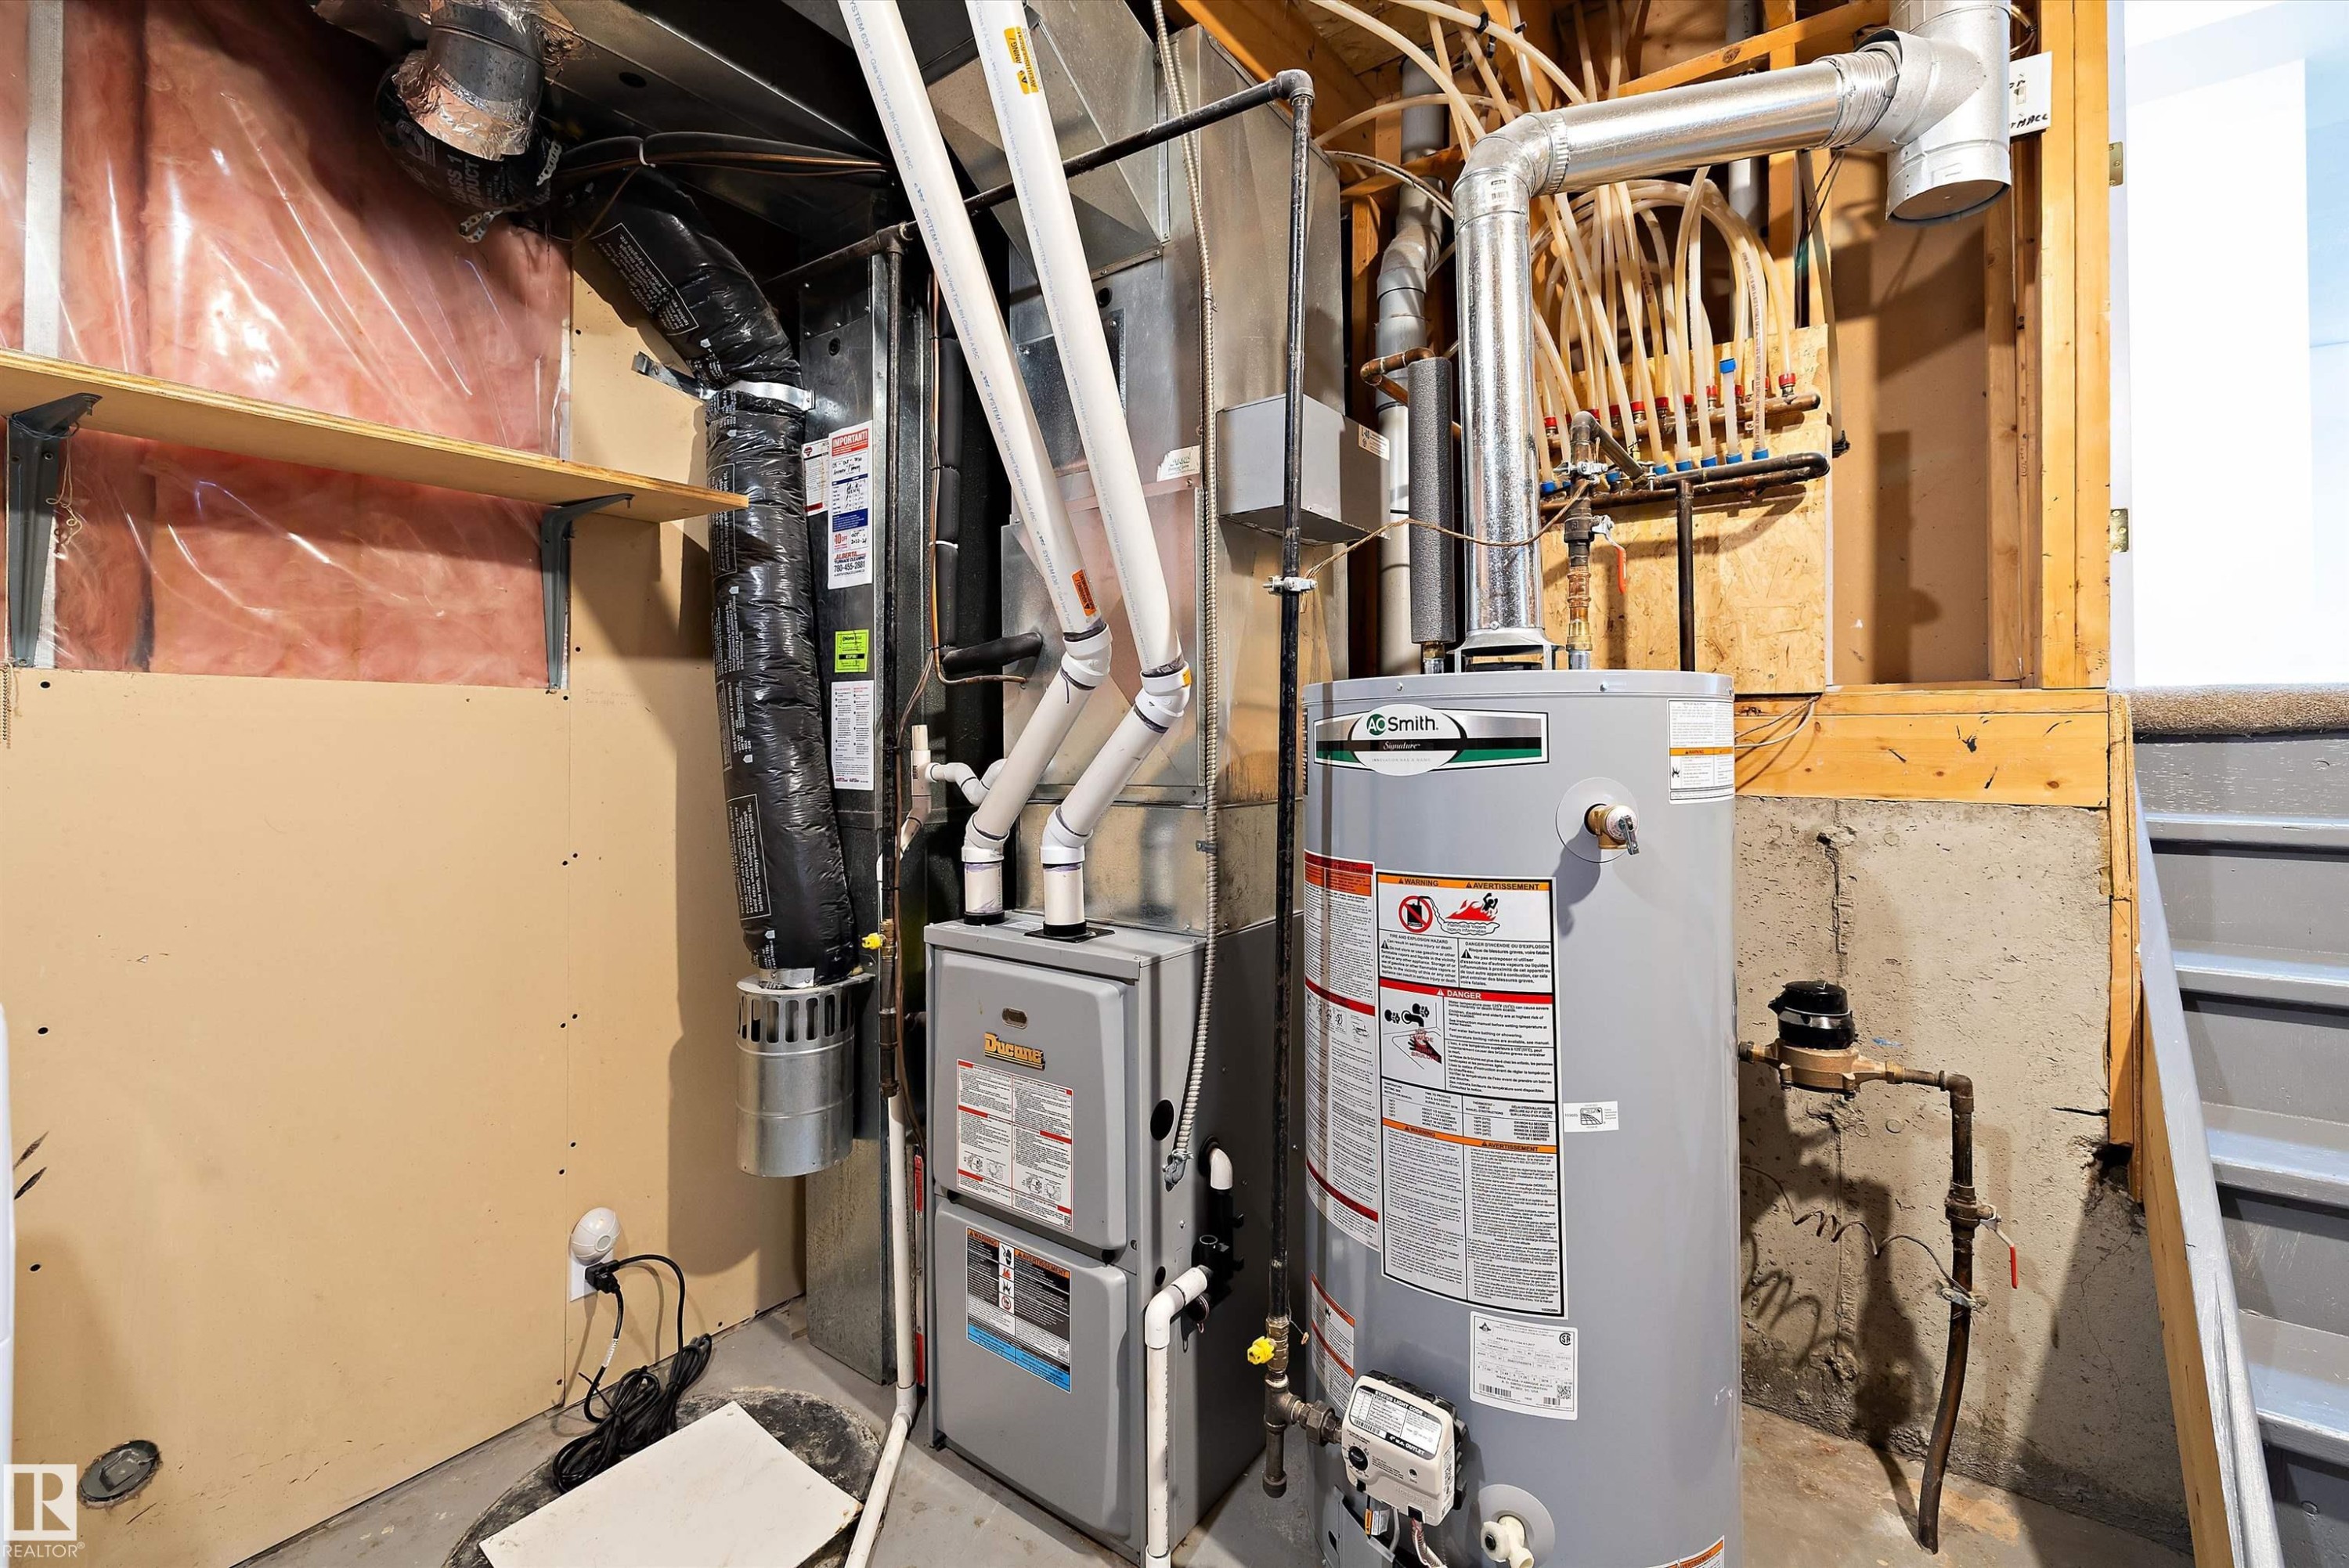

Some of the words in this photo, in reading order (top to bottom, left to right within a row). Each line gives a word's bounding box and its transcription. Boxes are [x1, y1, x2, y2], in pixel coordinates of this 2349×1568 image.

[850, 0, 864, 31] YSTEM
[861, 31, 871, 49] 636
[870, 59, 879, 74] Gas
[876, 74, 885, 92] Vent
[882, 92, 892, 110] Type
[889, 111, 896, 122] BH
[893, 123, 903, 145] Class
[922, 208, 938, 242] SYSTEM
[934, 242, 943, 256] 636
[962, 319, 970, 337] Class
[987, 392, 1001, 420] SYSTEM
[1009, 454, 1017, 467] Vent
[1018, 480, 1024, 490] BH
[1021, 489, 1030, 506] Class
[835, 551, 857, 560] ALBERTA
[1042, 550, 1056, 576] SYSTEM
[1405, 878, 1438, 887] WARNING
[1473, 882, 1540, 891] AVERTISSEMENT
[1447, 989, 1481, 999] DANGER
[984, 1032, 1044, 1064] Ducane
[1410, 1126, 1435, 1137] WARNING
[1488, 1143, 1539, 1152] AVERTISSEMENT
[972, 1231, 998, 1247] WARNING
[1022, 1253, 1066, 1276] AVERTISSEMENT
[1375, 1390, 1394, 1402] STATUS
[1394, 1399, 1409, 1409] LIGHT
[1409, 1405, 1423, 1415] CODE
[1405, 1444, 1425, 1455] OUTLET
